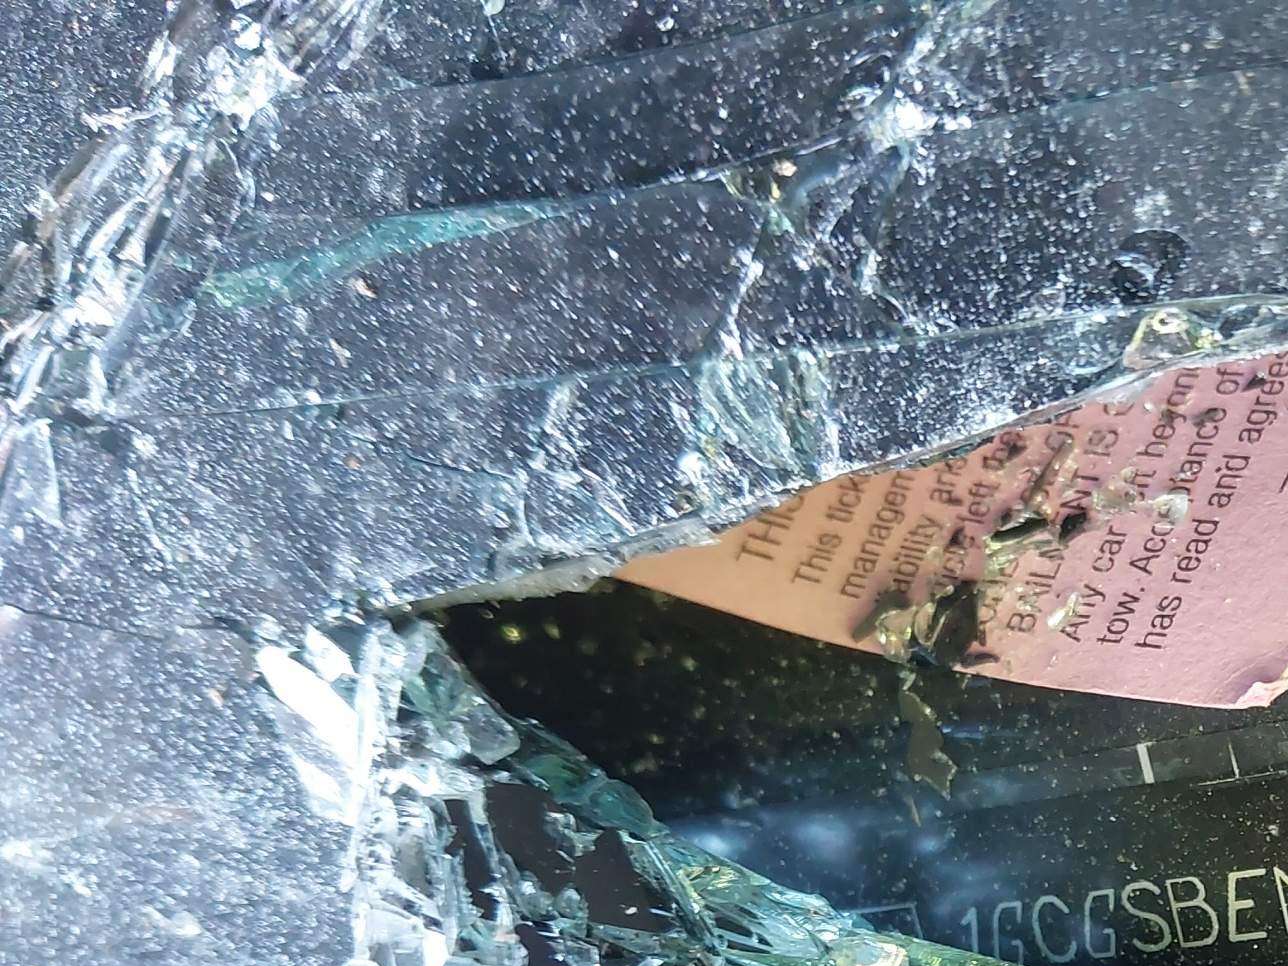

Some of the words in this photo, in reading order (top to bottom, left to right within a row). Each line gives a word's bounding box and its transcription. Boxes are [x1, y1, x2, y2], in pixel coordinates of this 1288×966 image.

[791, 531, 842, 584] This
[826, 475, 871, 525] tick
[876, 512, 945, 603] ability
[959, 481, 1000, 524] left
[1006, 469, 1100, 632] BAILMNT
[1088, 428, 1120, 457] IS
[1096, 586, 1144, 645] tow.
[1129, 407, 1228, 576] Accptance
[1216, 366, 1244, 395] of
[1134, 594, 1182, 649] has
[1172, 518, 1221, 585] read
[1208, 453, 1252, 509] and
[1059, 582, 1106, 642] Any
[1092, 523, 1127, 574] car
